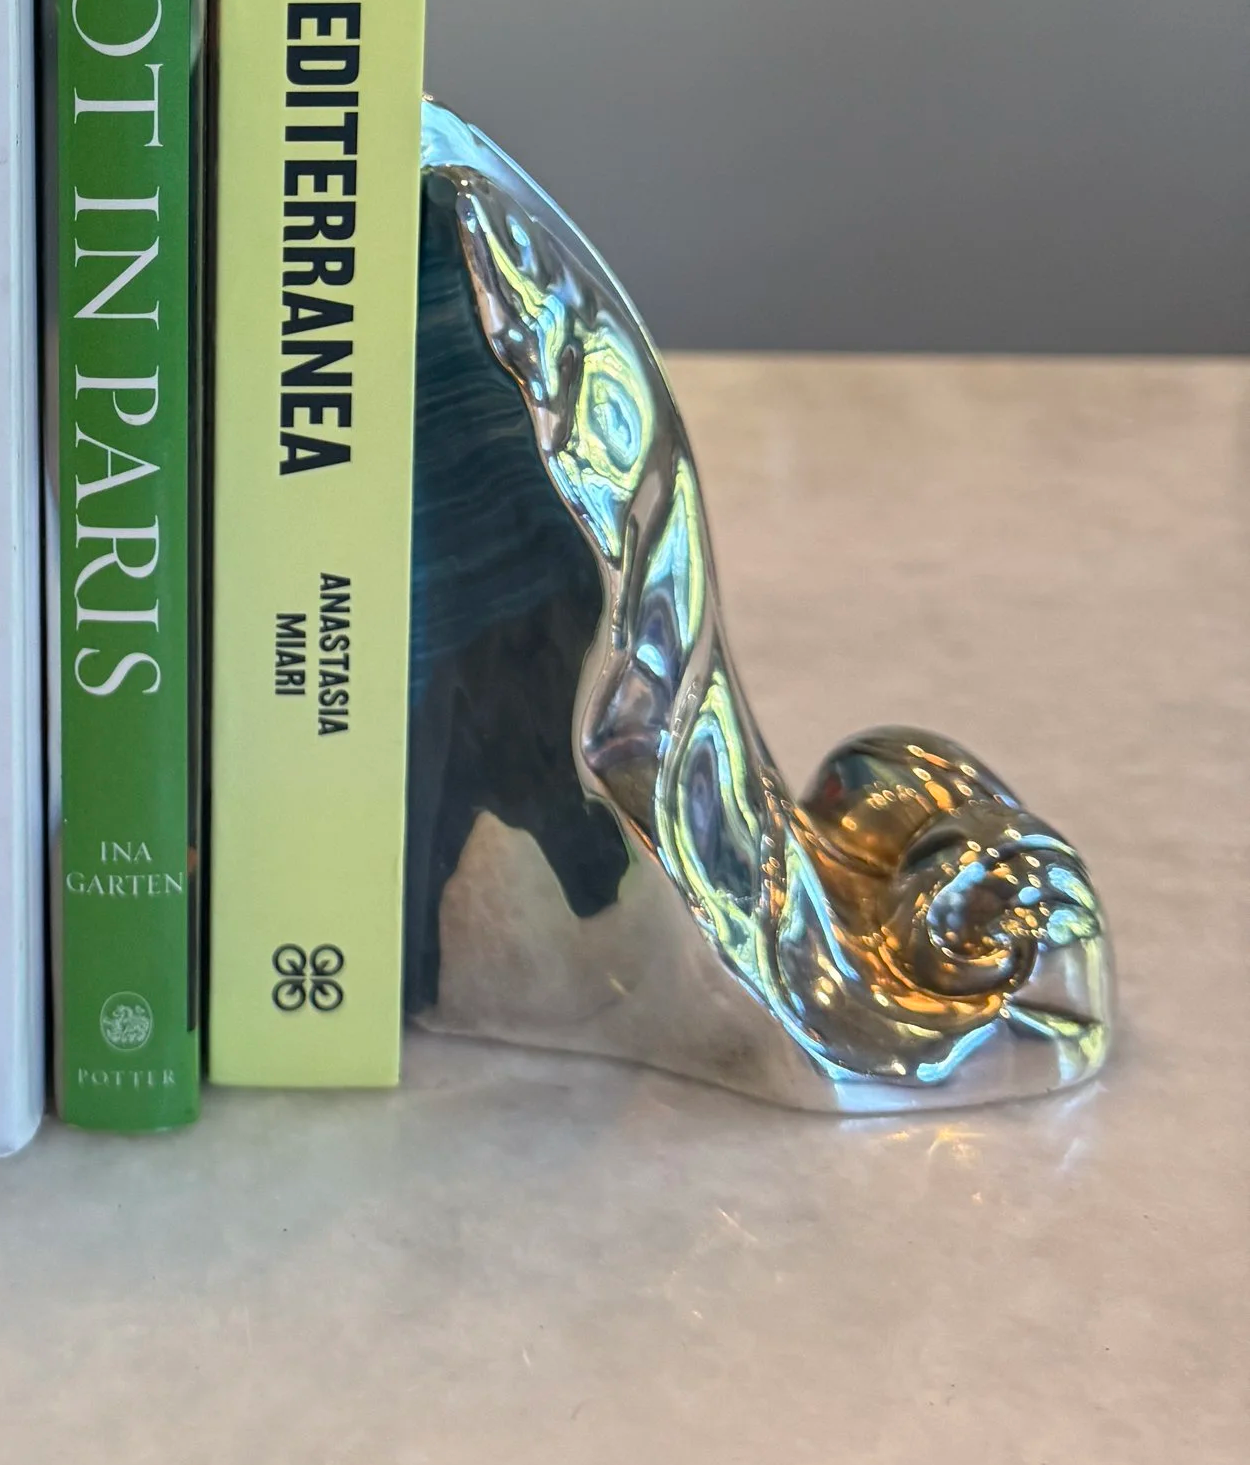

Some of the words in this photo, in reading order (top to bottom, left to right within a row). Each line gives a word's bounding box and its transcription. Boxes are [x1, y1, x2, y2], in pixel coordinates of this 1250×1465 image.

[73, 186, 160, 330] IN
[73, 365, 161, 696] PARIS
[275, 613, 307, 696] MIARI
[317, 572, 351, 736] ANASTASIA
[66, 871, 183, 896] GARTEN
[100, 841, 152, 862] INA
[78, 1068, 176, 1087] POTTER
